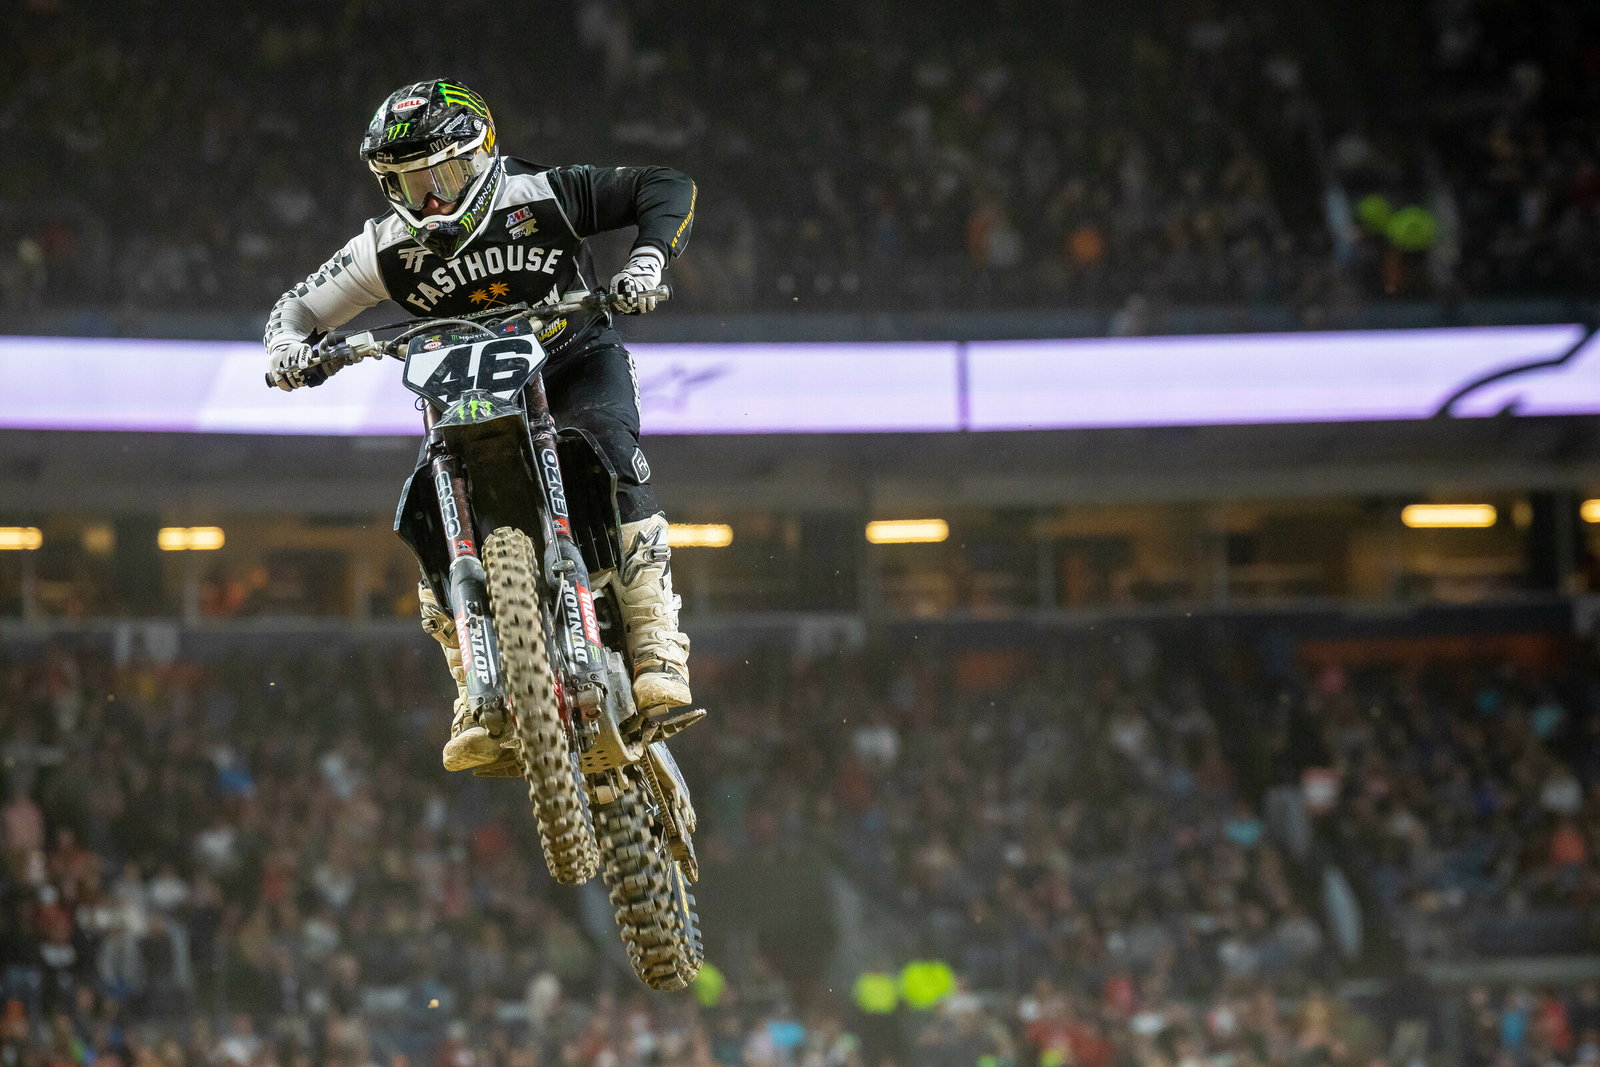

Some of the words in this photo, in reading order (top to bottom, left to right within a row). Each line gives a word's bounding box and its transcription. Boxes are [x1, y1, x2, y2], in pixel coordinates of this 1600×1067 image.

[397, 100, 422, 109] BELL
[505, 206, 534, 227] AMA
[406, 245, 563, 312] FASTHOUSE
[422, 338, 534, 404] 46
[435, 471, 461, 541] ENZO
[542, 448, 569, 517] ENZO
[562, 579, 589, 664] DUNLOP
[580, 591, 598, 645] MOTUL
